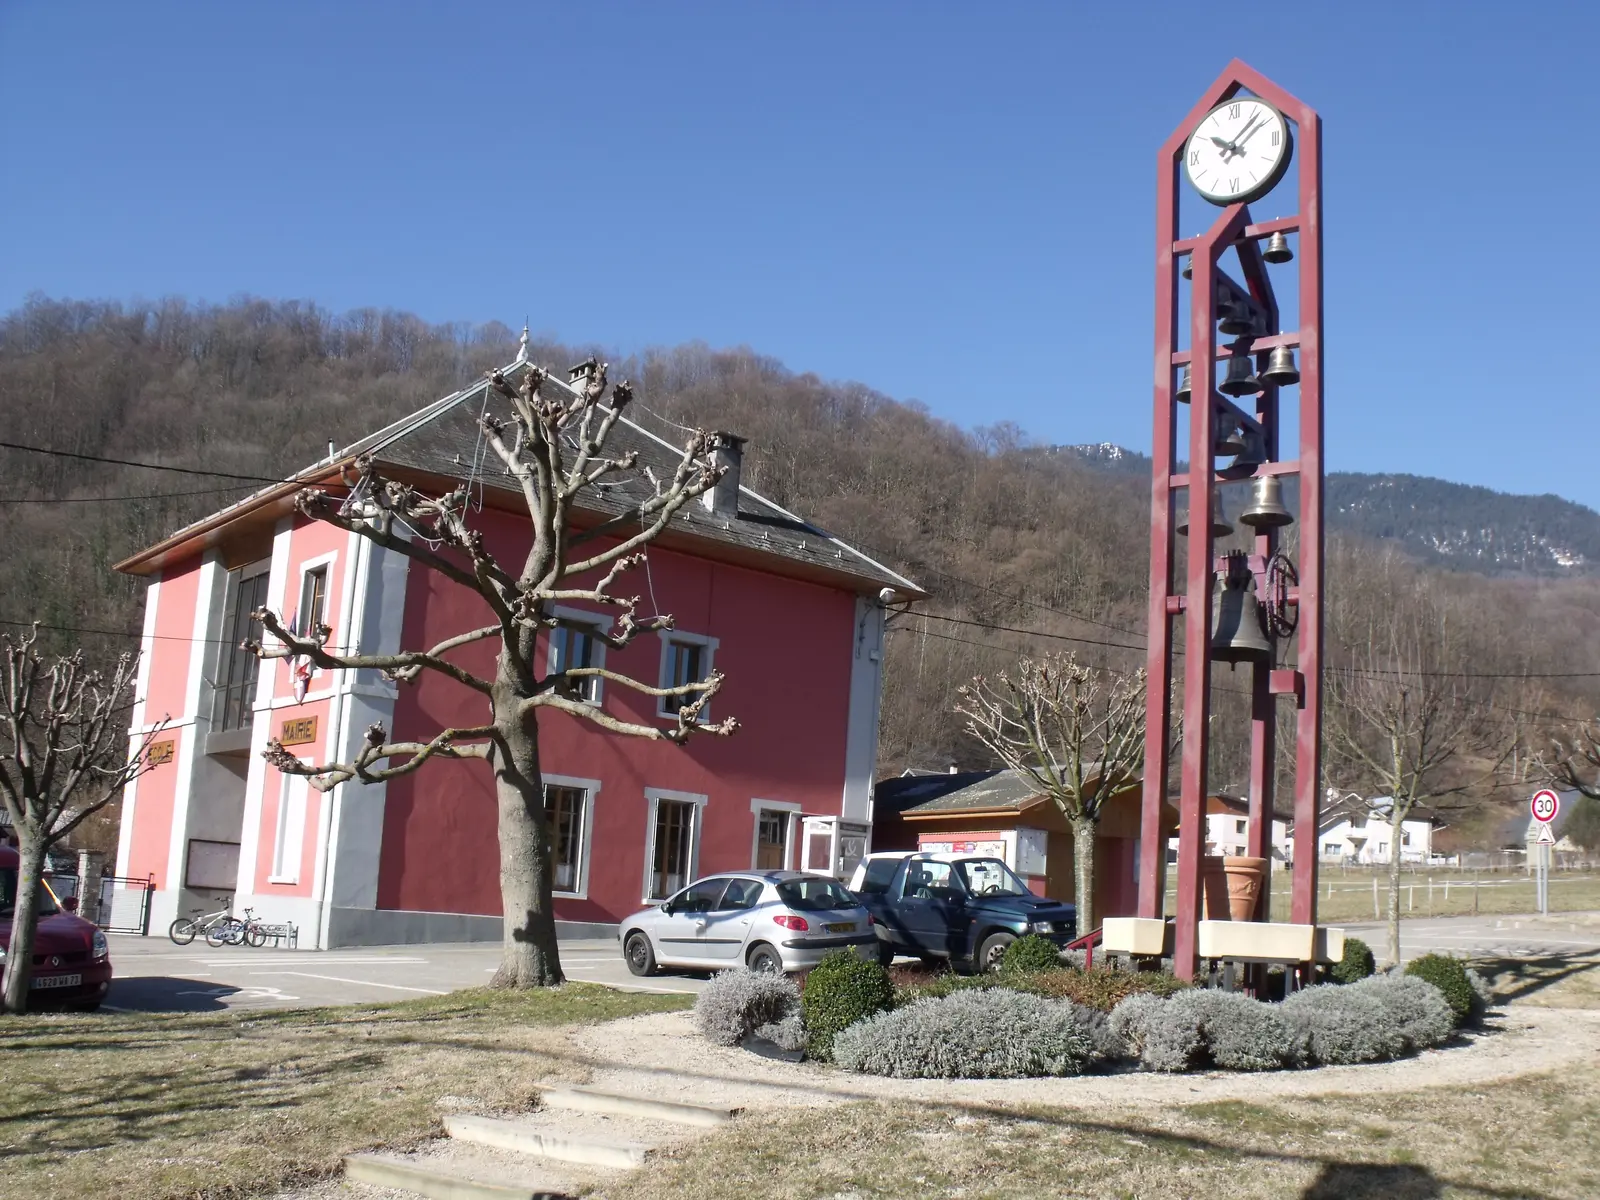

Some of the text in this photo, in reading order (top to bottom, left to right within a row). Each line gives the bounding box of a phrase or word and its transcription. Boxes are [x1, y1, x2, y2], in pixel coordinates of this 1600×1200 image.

[1228, 103, 1241, 120] XII
[1271, 130, 1280, 147] III
[1190, 150, 1200, 167] IX
[1229, 177, 1240, 194] VI
[282, 720, 313, 741] MAIRIE
[1537, 799, 1553, 813] 30
